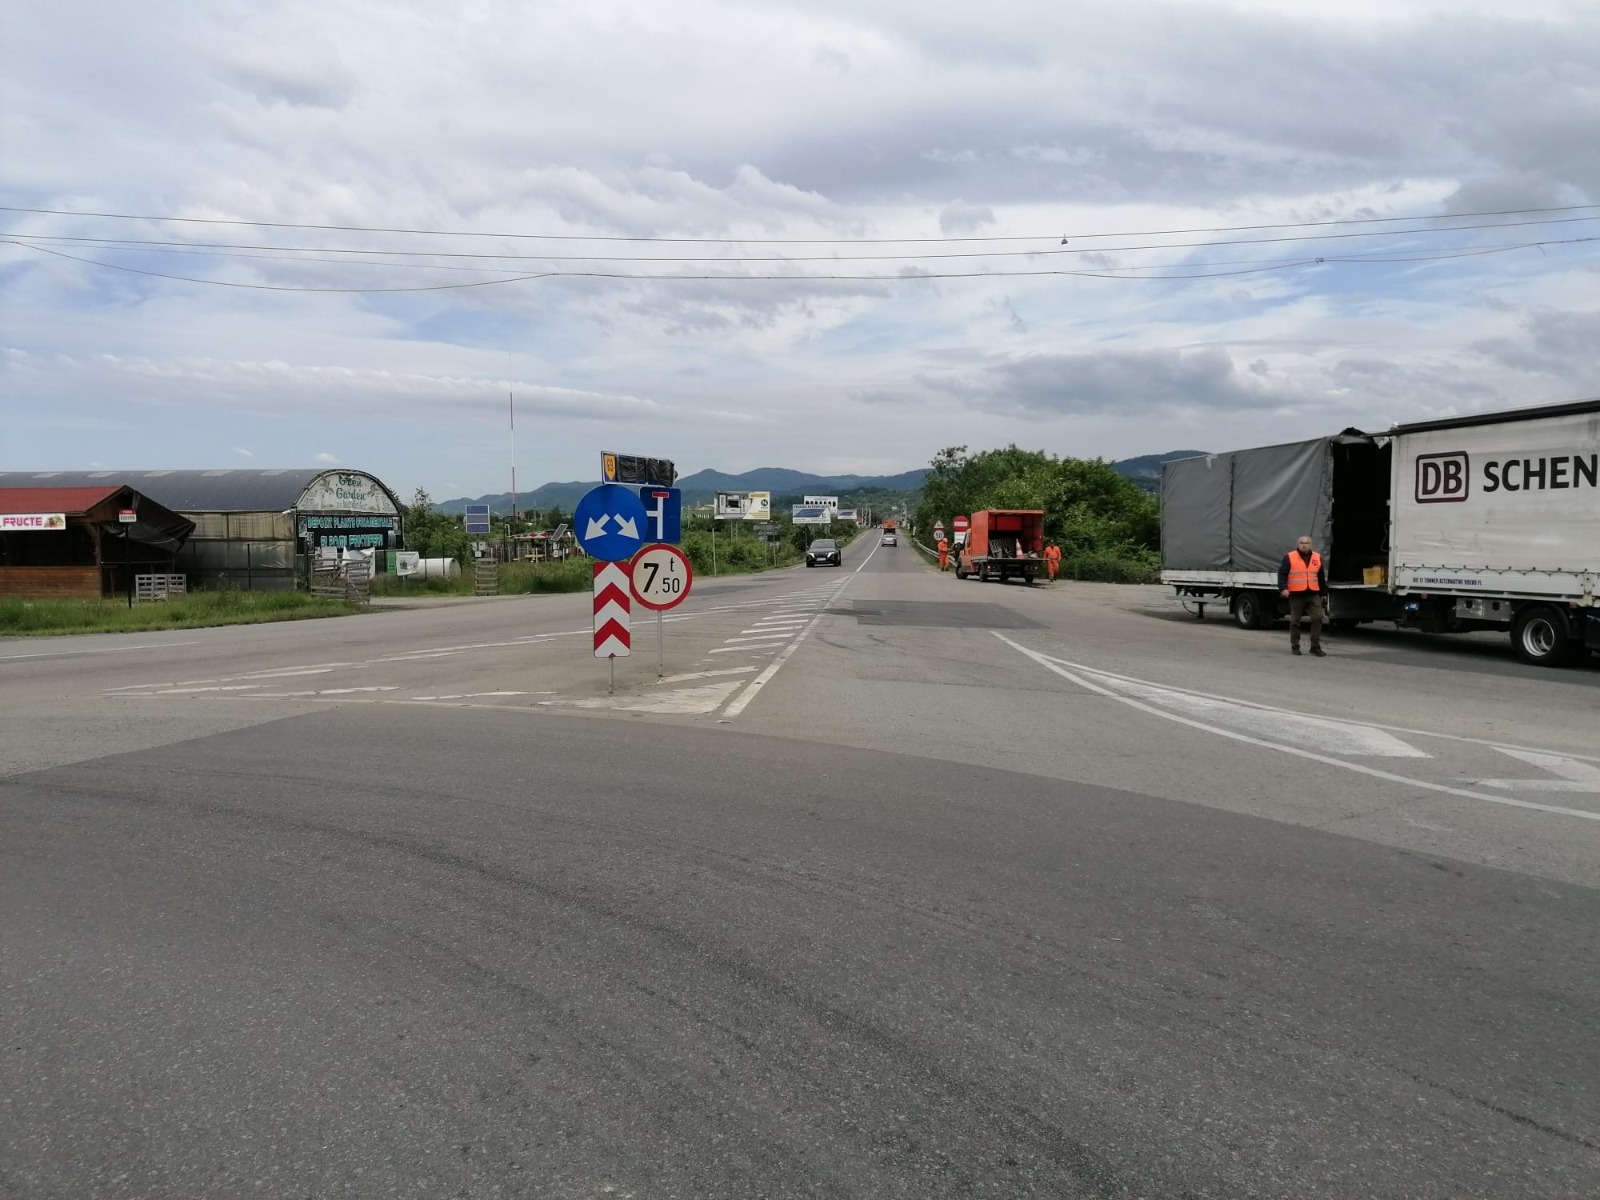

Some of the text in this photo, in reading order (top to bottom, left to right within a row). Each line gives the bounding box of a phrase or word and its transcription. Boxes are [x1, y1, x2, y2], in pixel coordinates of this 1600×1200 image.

[1422, 453, 1598, 495] DB SCHEN
[3, 517, 42, 526] FRUCTE
[333, 517, 355, 528] PLANTE
